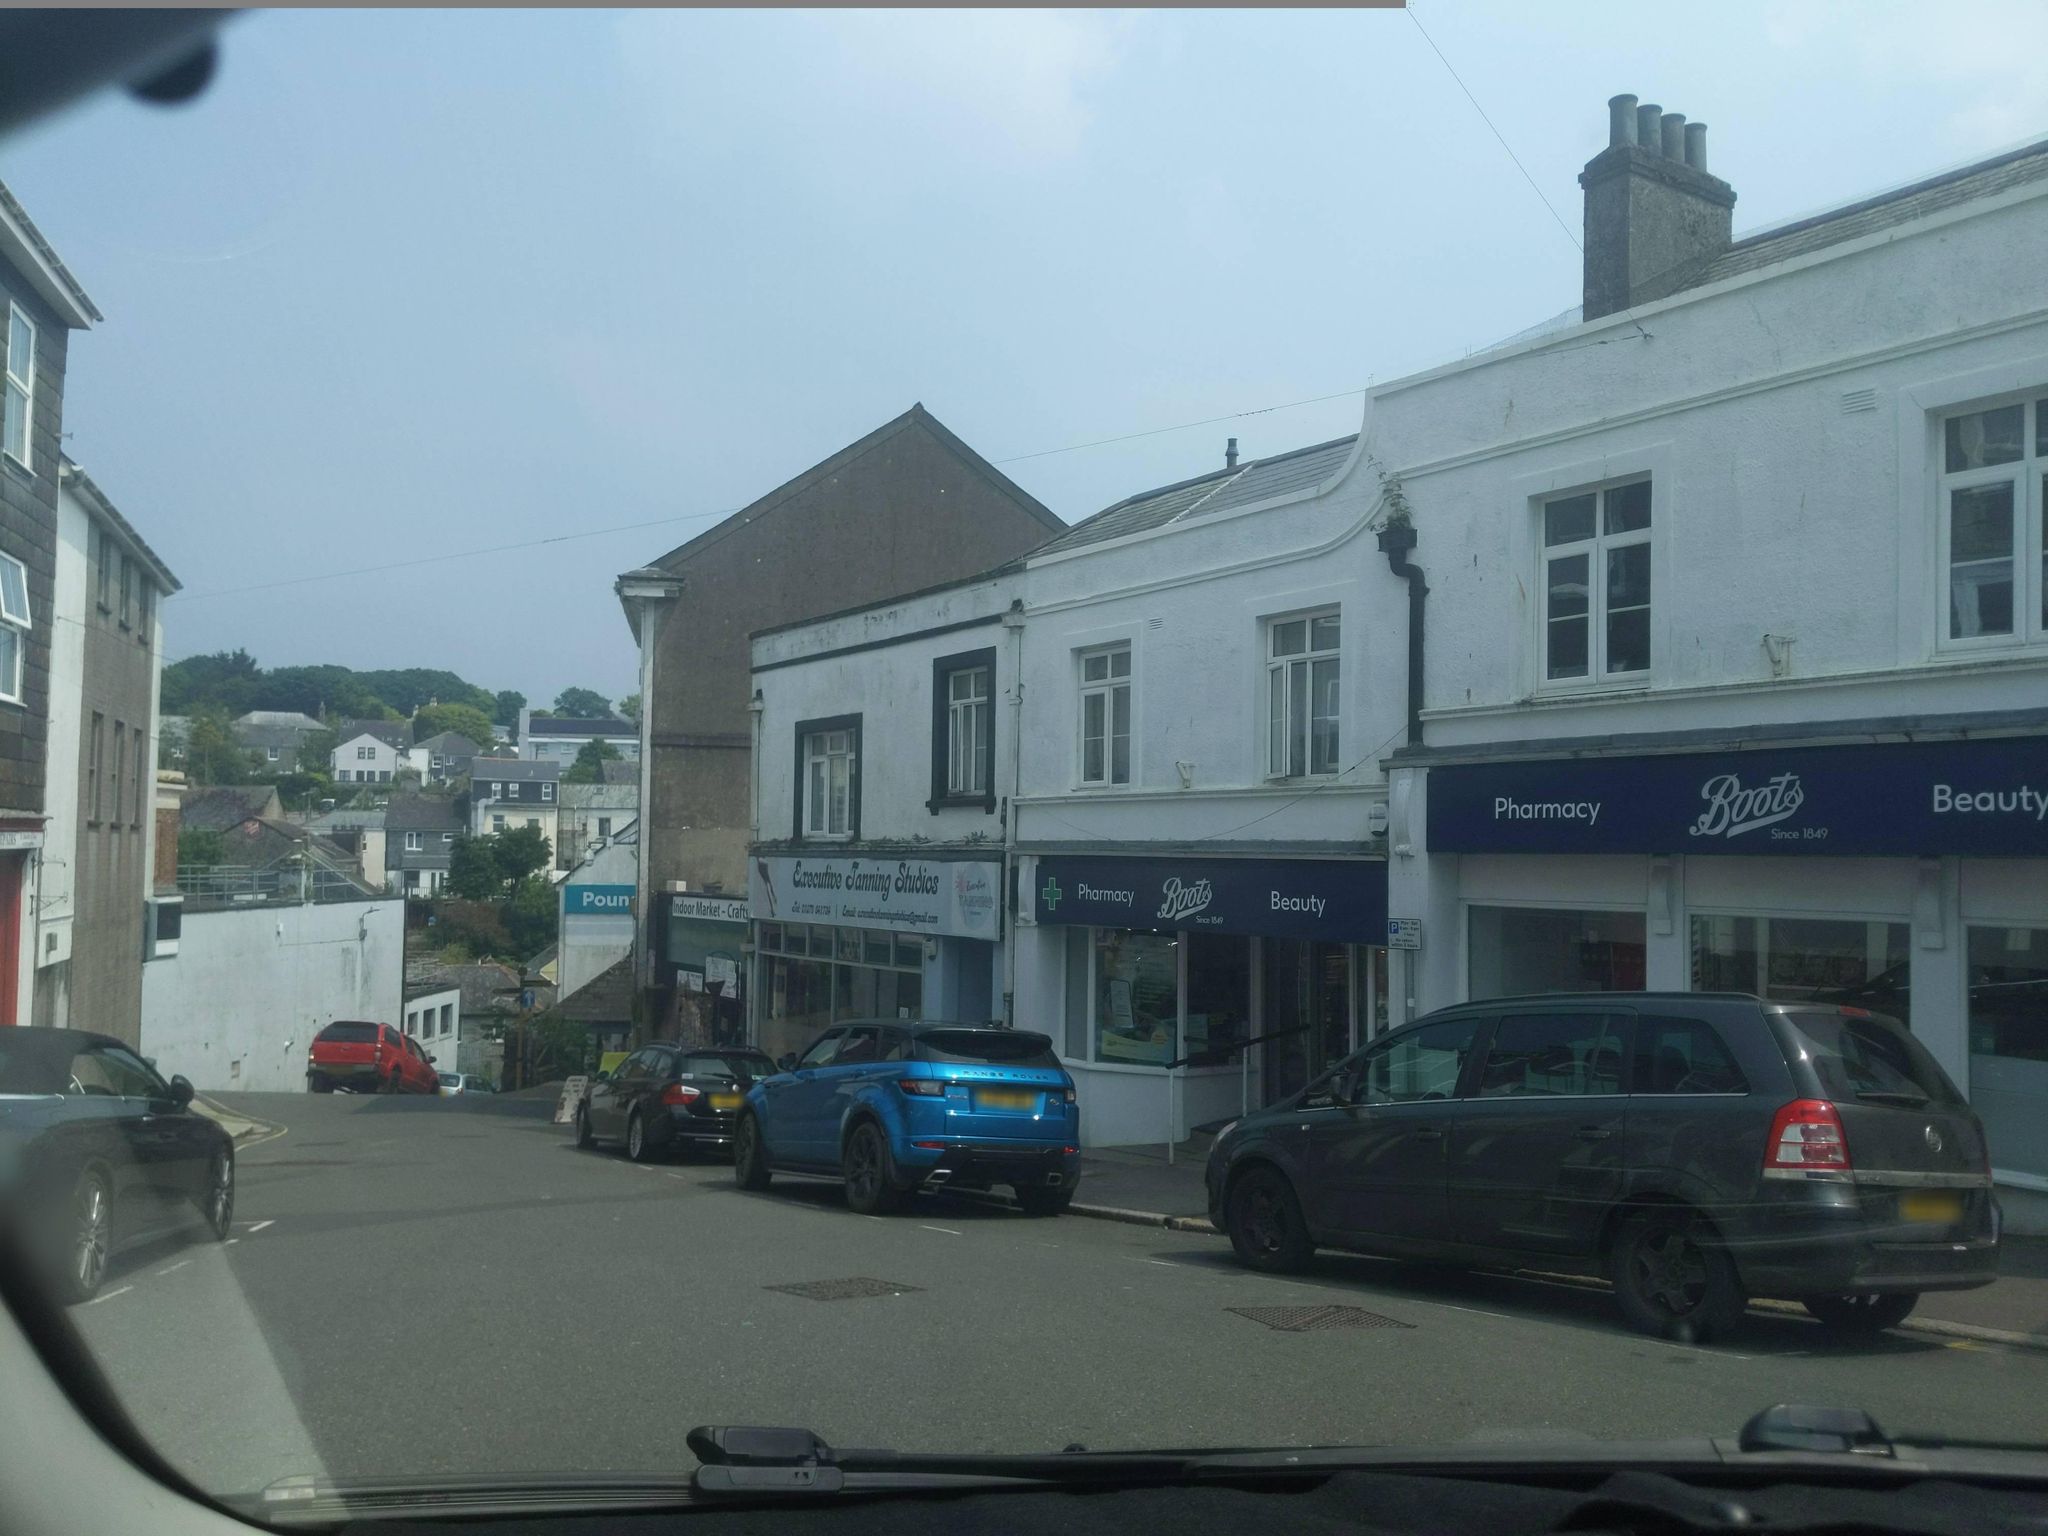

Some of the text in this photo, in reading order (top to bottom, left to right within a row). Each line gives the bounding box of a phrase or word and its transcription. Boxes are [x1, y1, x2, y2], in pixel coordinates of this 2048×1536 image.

[1495, 797, 1600, 825] Pharmacy
[1689, 772, 1804, 839] Boots
[1933, 784, 2048, 820] Beauty
[1771, 828, 1828, 840] Since 1849
[792, 860, 939, 901] Executive Tanning Studios
[582, 891, 634, 907] Poun
[1078, 883, 1134, 907] Pharmacy
[1157, 877, 1213, 921] Boots
[1271, 890, 1326, 918] Beauty
[674, 900, 695, 914] Indoor
[696, 901, 720, 918] Market
[727, 903, 749, 920] Crafts
[1195, 915, 1224, 924] Since 1849
[1012, 1073, 1049, 1081] ROVER
